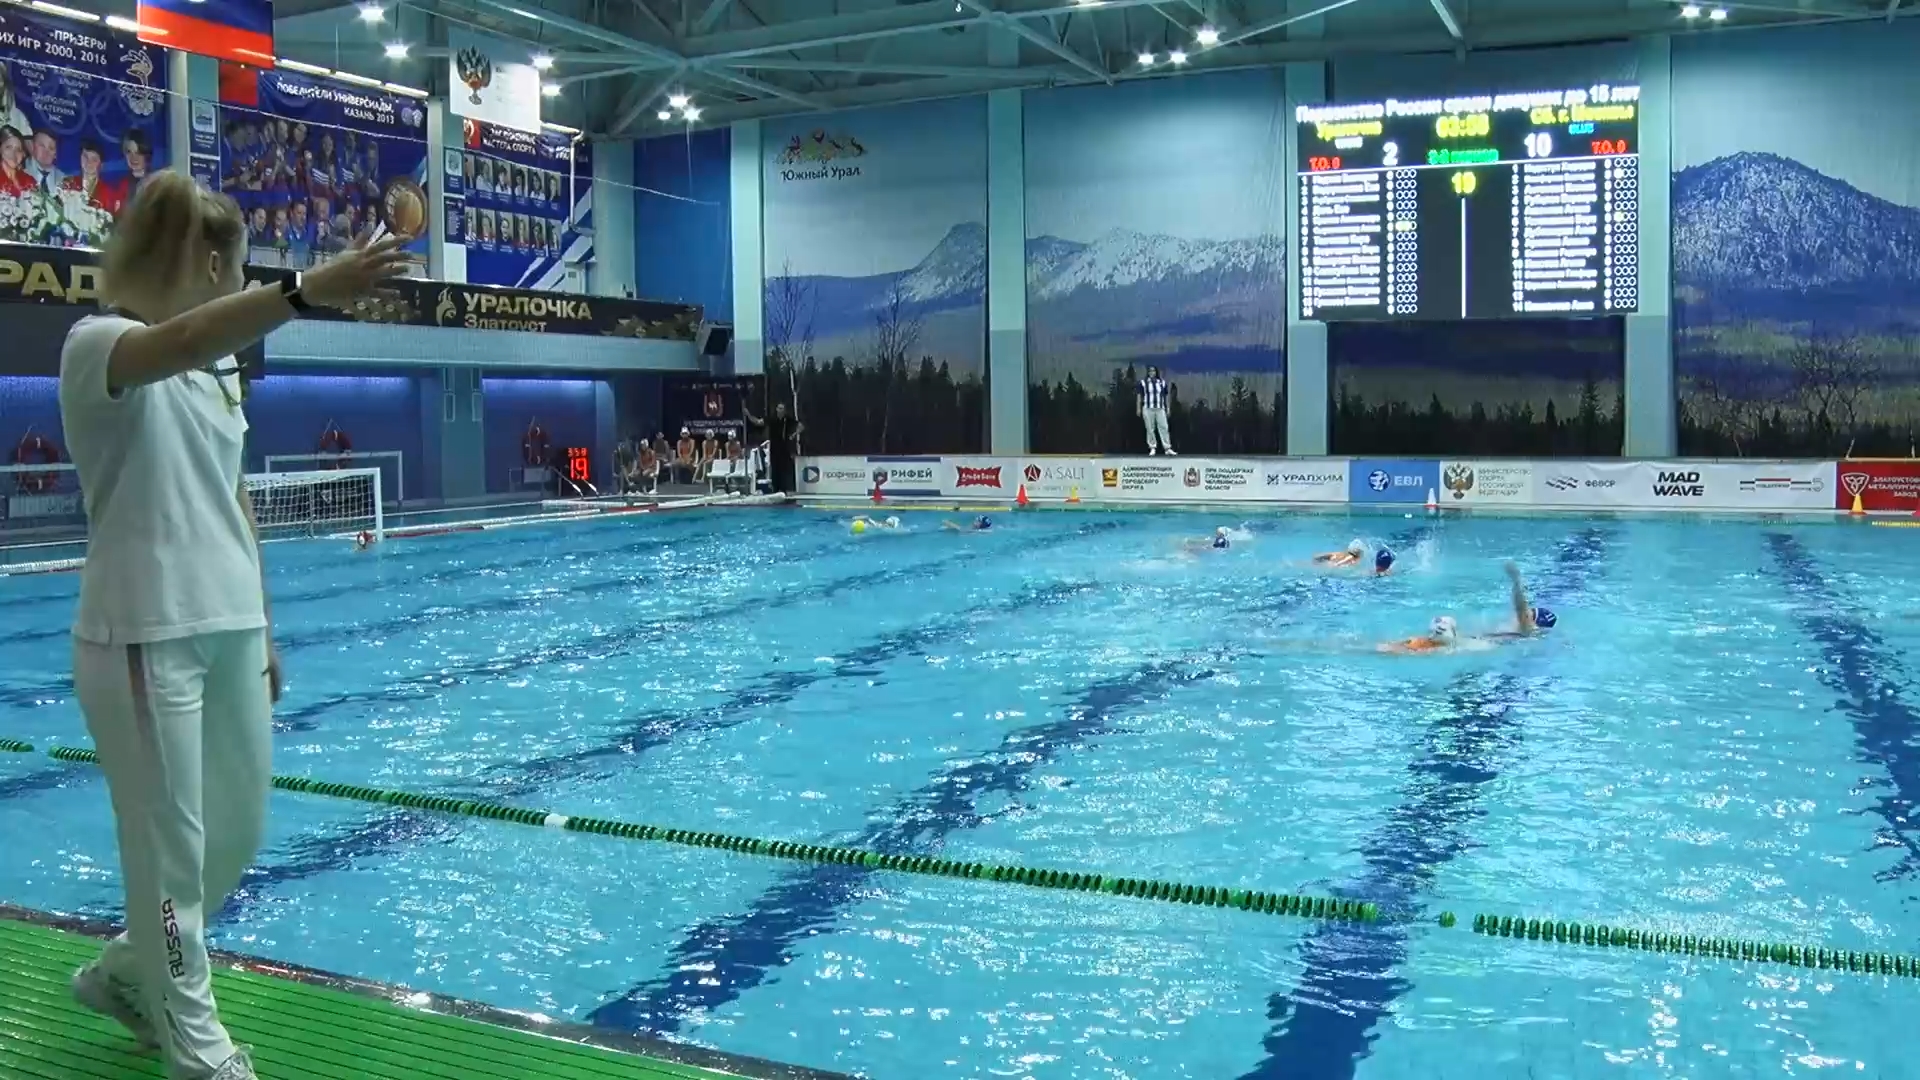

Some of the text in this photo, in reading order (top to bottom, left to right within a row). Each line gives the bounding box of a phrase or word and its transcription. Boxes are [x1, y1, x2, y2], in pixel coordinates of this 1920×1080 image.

[18, 36, 41, 49] ИГР
[81, 51, 107, 65] 2016
[277, 82, 332, 100] ПОБЕДИТЕЛИ
[344, 107, 395, 124] КАЗАНЬ 2013
[1524, 132, 1552, 157] 10
[1382, 142, 1399, 166] 2
[781, 166, 861, 181] Южный Урал
[463, 291, 593, 321] УРАЛОЧКА
[464, 313, 548, 333] Златоуст
[571, 458, 588, 480] 19
[891, 468, 933, 479] РИФЕЙ
[1056, 467, 1085, 480] SALT
[1657, 471, 1700, 483] MAD
[1282, 473, 1343, 483] УРАЛХИМ
[1394, 475, 1423, 486] ЕВЛ
[1652, 484, 1704, 497] WAVE
[161, 898, 185, 979] RUSSIA
